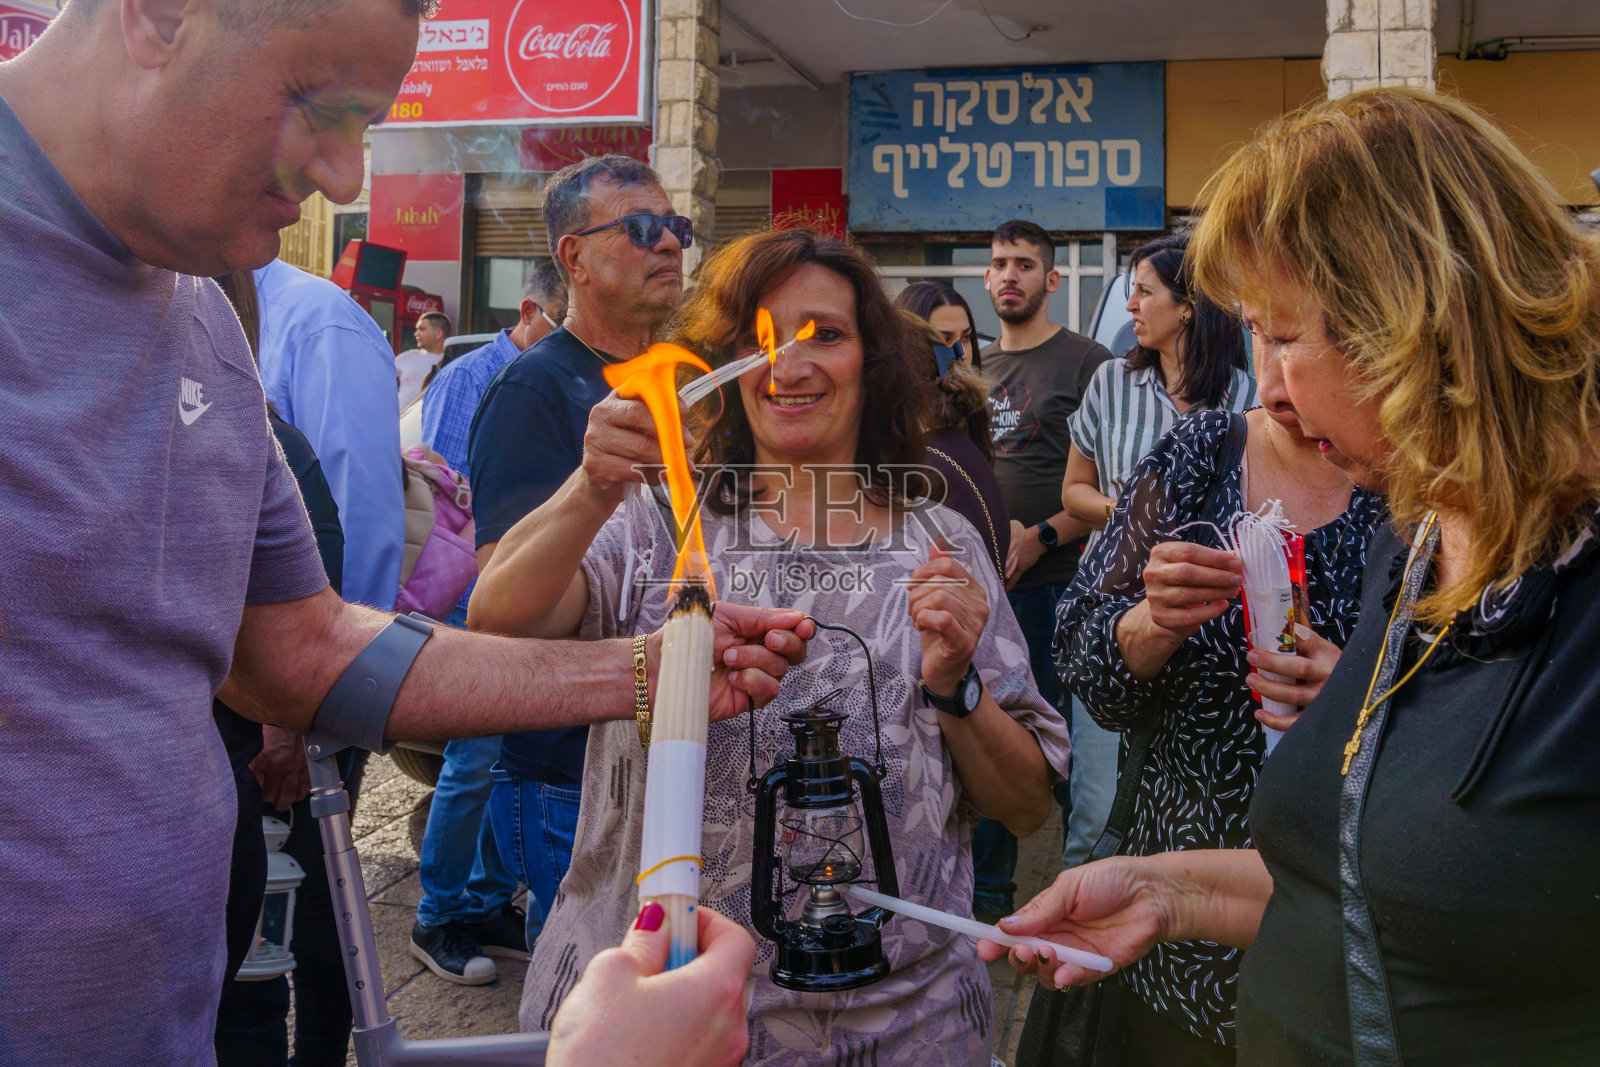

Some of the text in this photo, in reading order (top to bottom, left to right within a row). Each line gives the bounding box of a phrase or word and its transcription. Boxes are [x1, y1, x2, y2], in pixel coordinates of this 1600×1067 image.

[519, 22, 618, 60] Coca-Cola
[411, 54, 488, 72] פלאפל ושווארמ
[391, 102, 423, 118] 180
[912, 72, 1094, 133] אלסקה
[872, 136, 1142, 199] ספורטלייף
[392, 206, 441, 226] Jabaly
